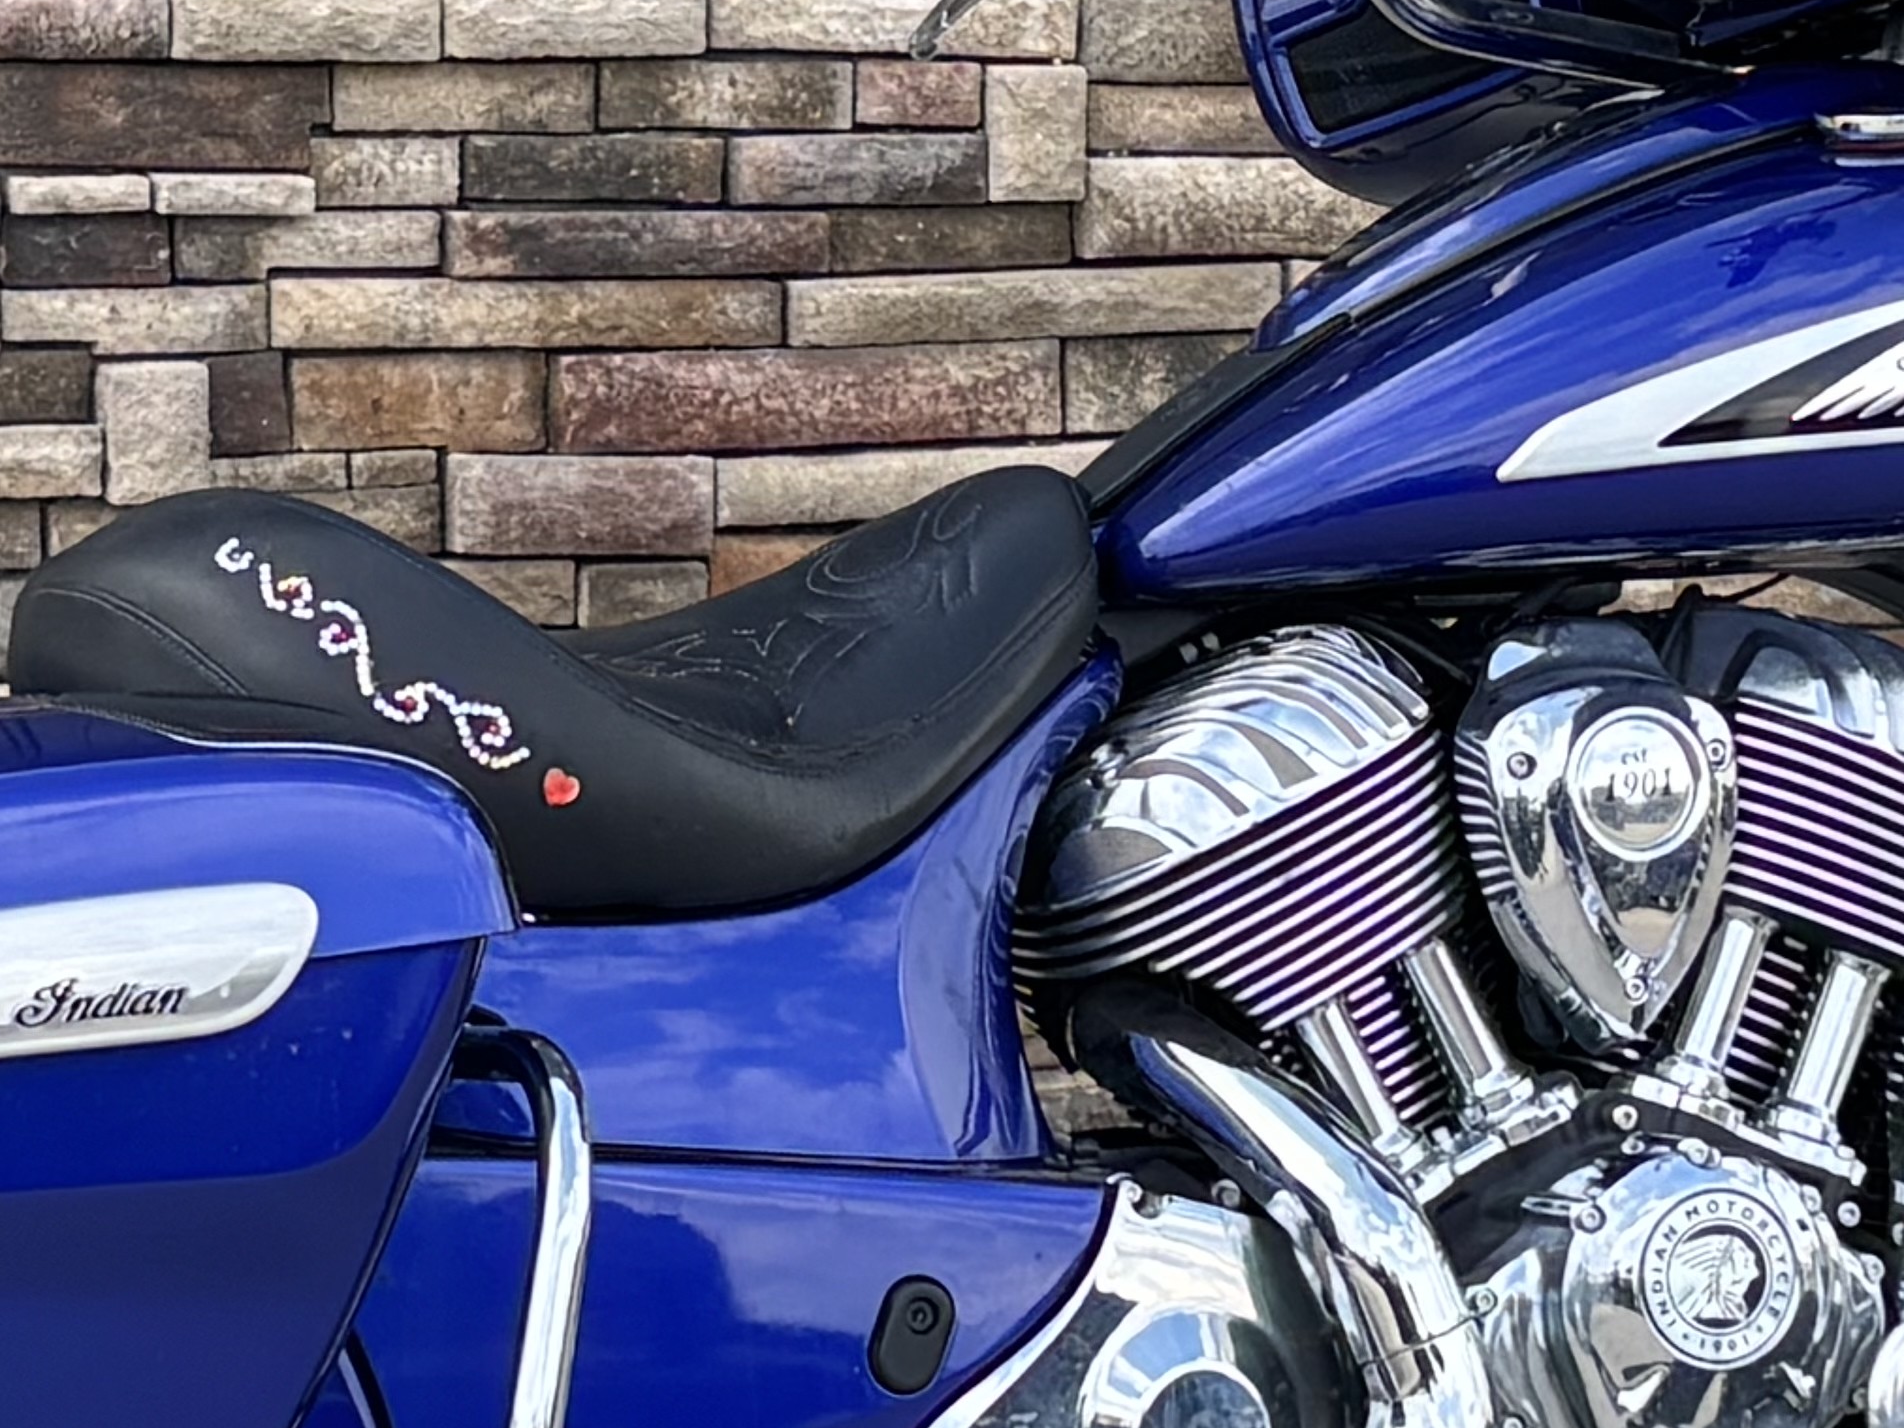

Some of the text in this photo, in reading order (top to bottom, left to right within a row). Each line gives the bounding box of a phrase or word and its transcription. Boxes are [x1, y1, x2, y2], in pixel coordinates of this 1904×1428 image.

[1605, 767, 1673, 802] 1901
[15, 977, 188, 1029] Indian
[1652, 1200, 1789, 1327] INDIAN MOTORCYCLE
